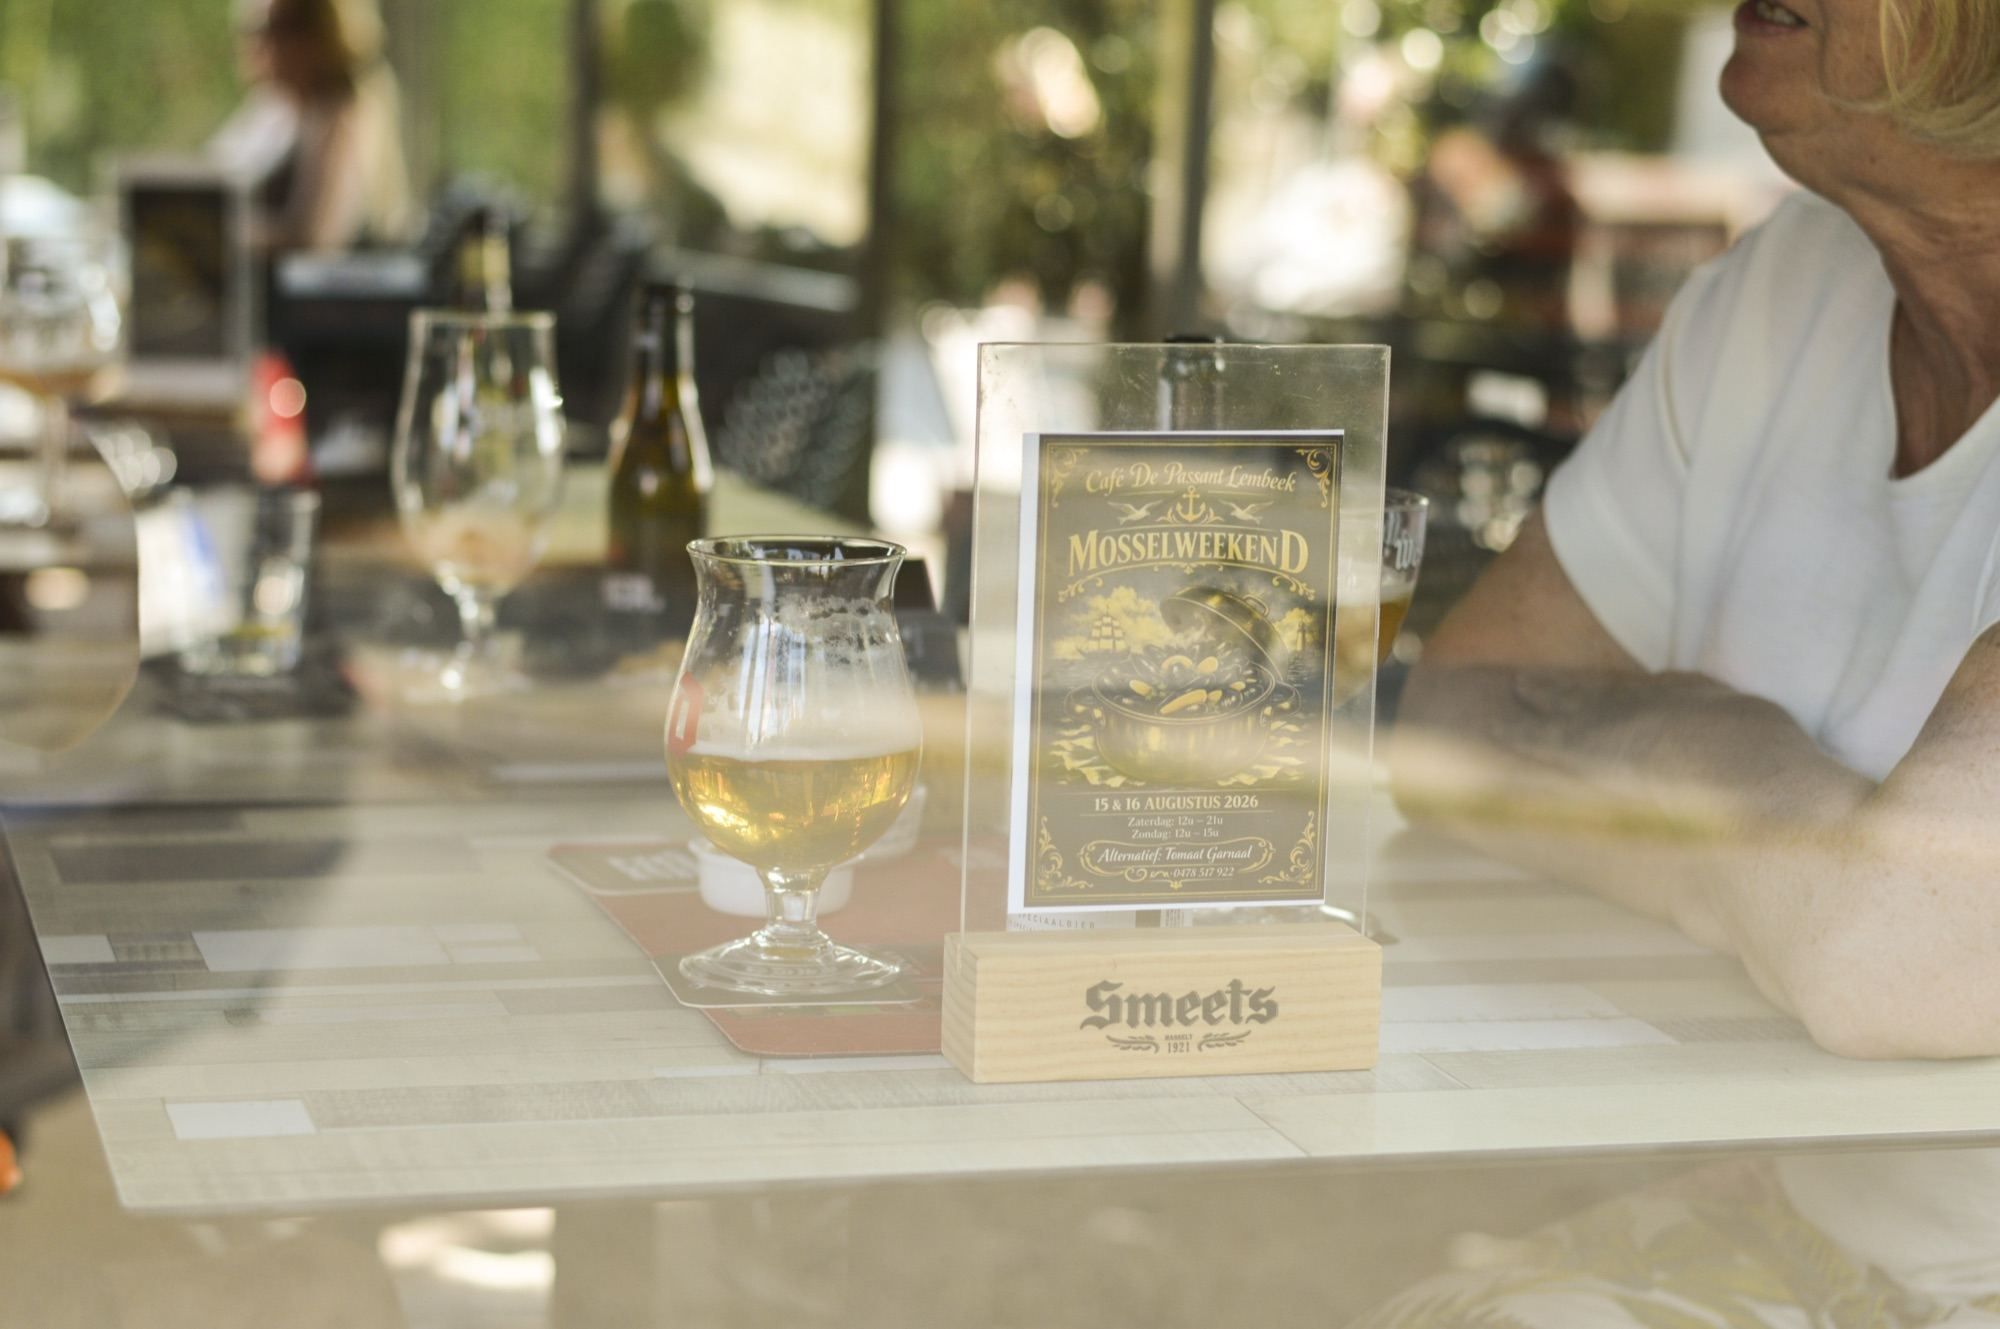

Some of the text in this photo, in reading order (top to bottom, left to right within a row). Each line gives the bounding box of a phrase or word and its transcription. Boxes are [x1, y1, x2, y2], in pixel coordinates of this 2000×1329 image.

[1085, 461, 1296, 496] Café De Passant Lembeek
[1068, 529, 1309, 577] MOSSELWEEKEND
[1095, 794, 1259, 811] 15 & 16 AUGUSTUS 2026
[1127, 816, 1175, 828] Zaterdag:
[1178, 815, 1194, 826] 12u
[1206, 815, 1223, 825] 21u
[1131, 829, 1172, 840] Zondag:
[1175, 828, 1191, 838] 12u
[1203, 827, 1219, 838] 15u
[1097, 844, 1253, 864] Alternatief: Tomaat Garnaal
[1217, 866, 1235, 877] 922
[1080, 978, 1279, 1030] Smeets
[1168, 1041, 1190, 1054] 1921
